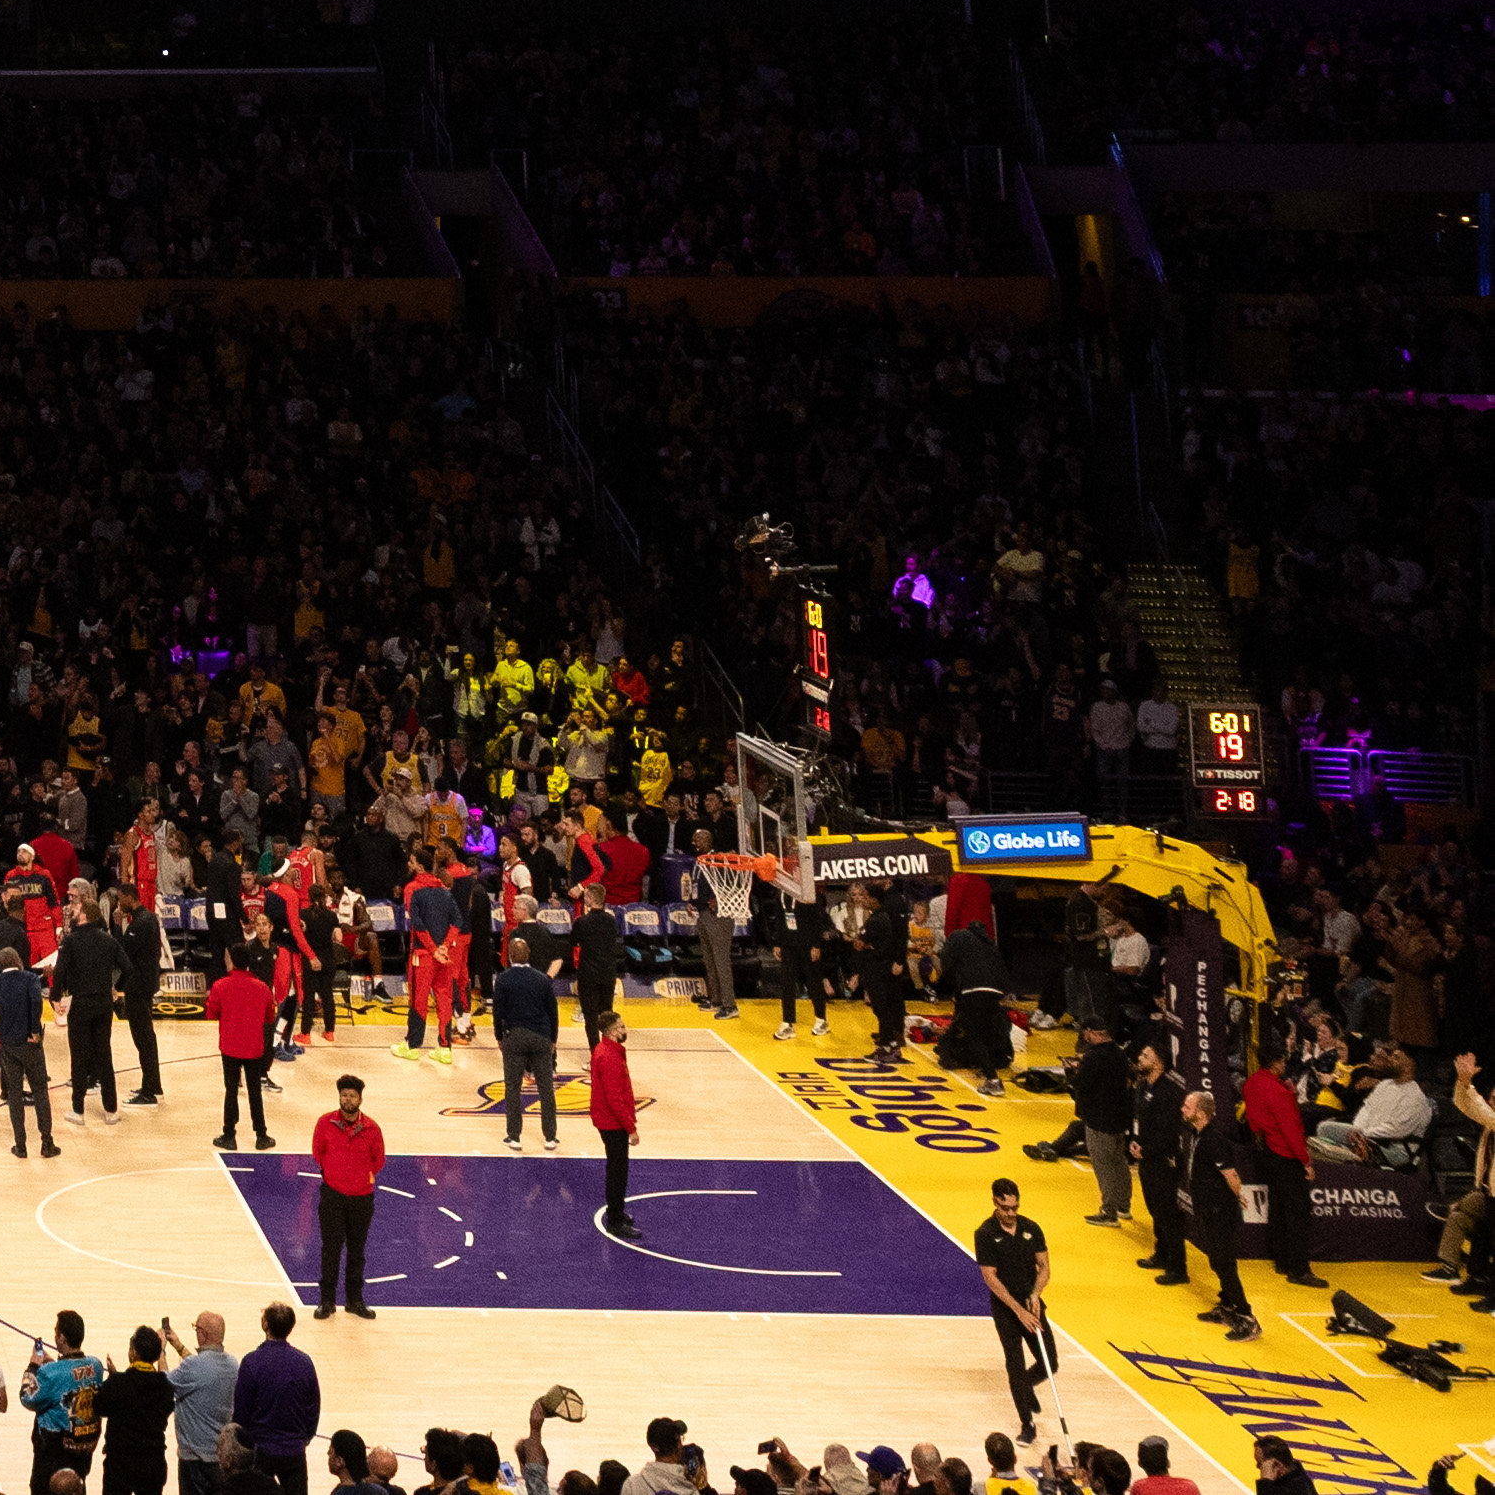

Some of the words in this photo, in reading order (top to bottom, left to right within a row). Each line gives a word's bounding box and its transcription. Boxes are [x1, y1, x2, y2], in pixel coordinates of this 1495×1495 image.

[1209, 711, 1251, 734] 6:01
[1219, 733, 1244, 761] 19
[992, 831, 1045, 851] Globe
[1046, 830, 1082, 848] Life
[166, 974, 202, 993] PRIME
[666, 979, 702, 998] PRIME
[814, 1057, 1001, 1155] bibigo
[1310, 1188, 1401, 1207] CHANGA
